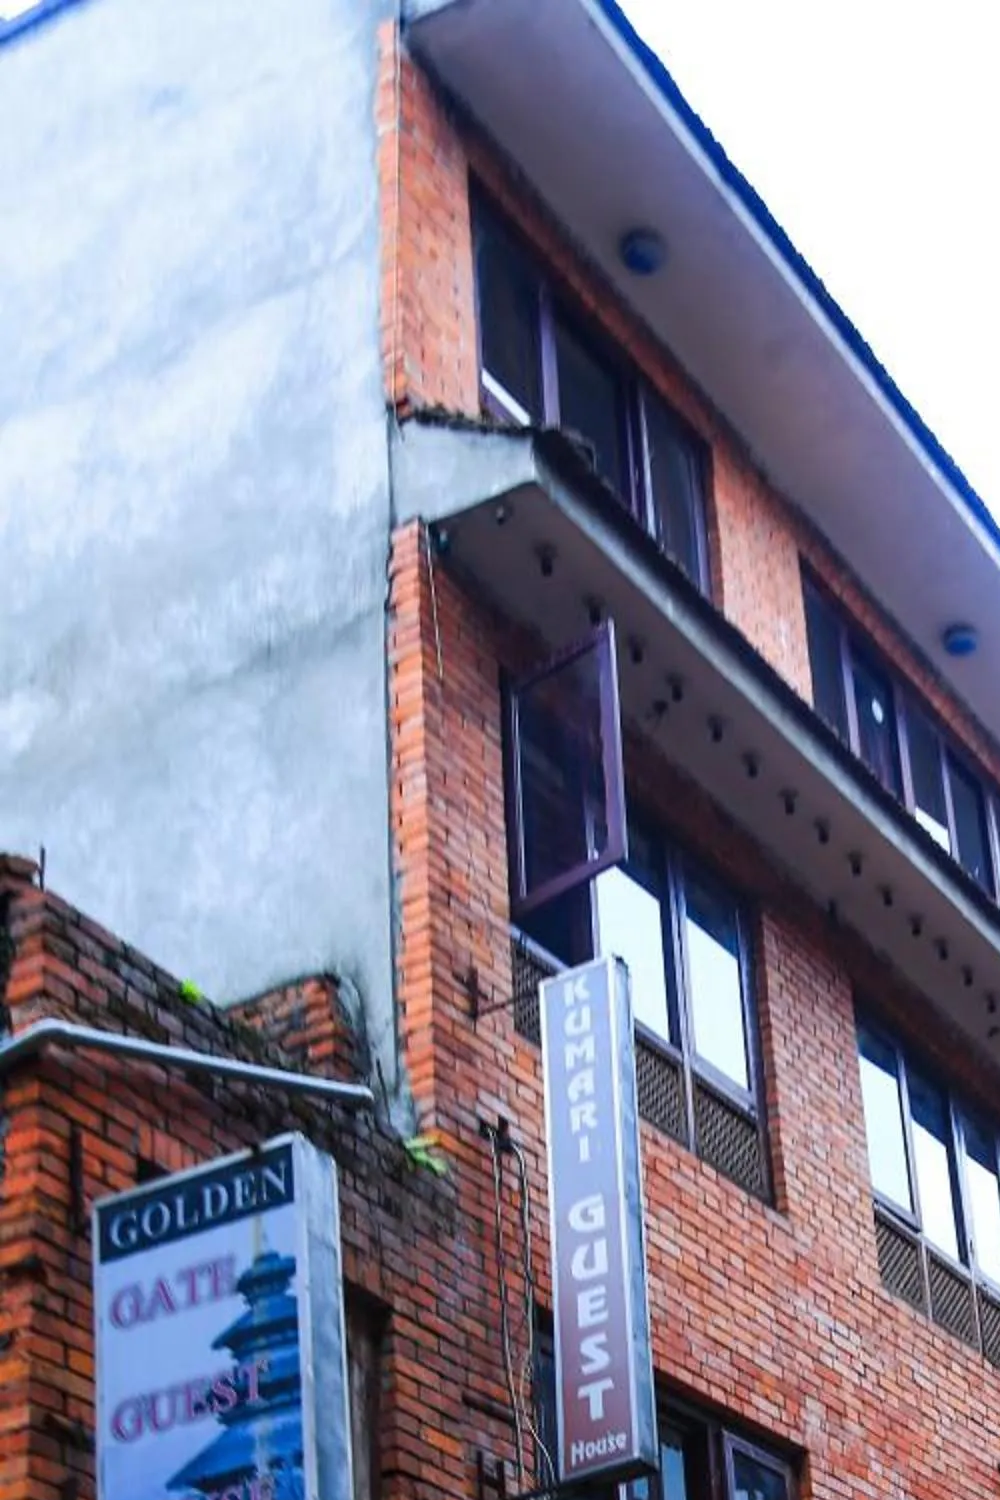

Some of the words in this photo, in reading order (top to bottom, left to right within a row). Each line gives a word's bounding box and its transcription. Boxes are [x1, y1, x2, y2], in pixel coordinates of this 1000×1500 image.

[109, 1160, 288, 1252] GOLDEN
[109, 1255, 237, 1332] GATE
[569, 1195, 615, 1422] GUEST
[109, 1357, 270, 1446] GUEST
[571, 1431, 628, 1467] House
